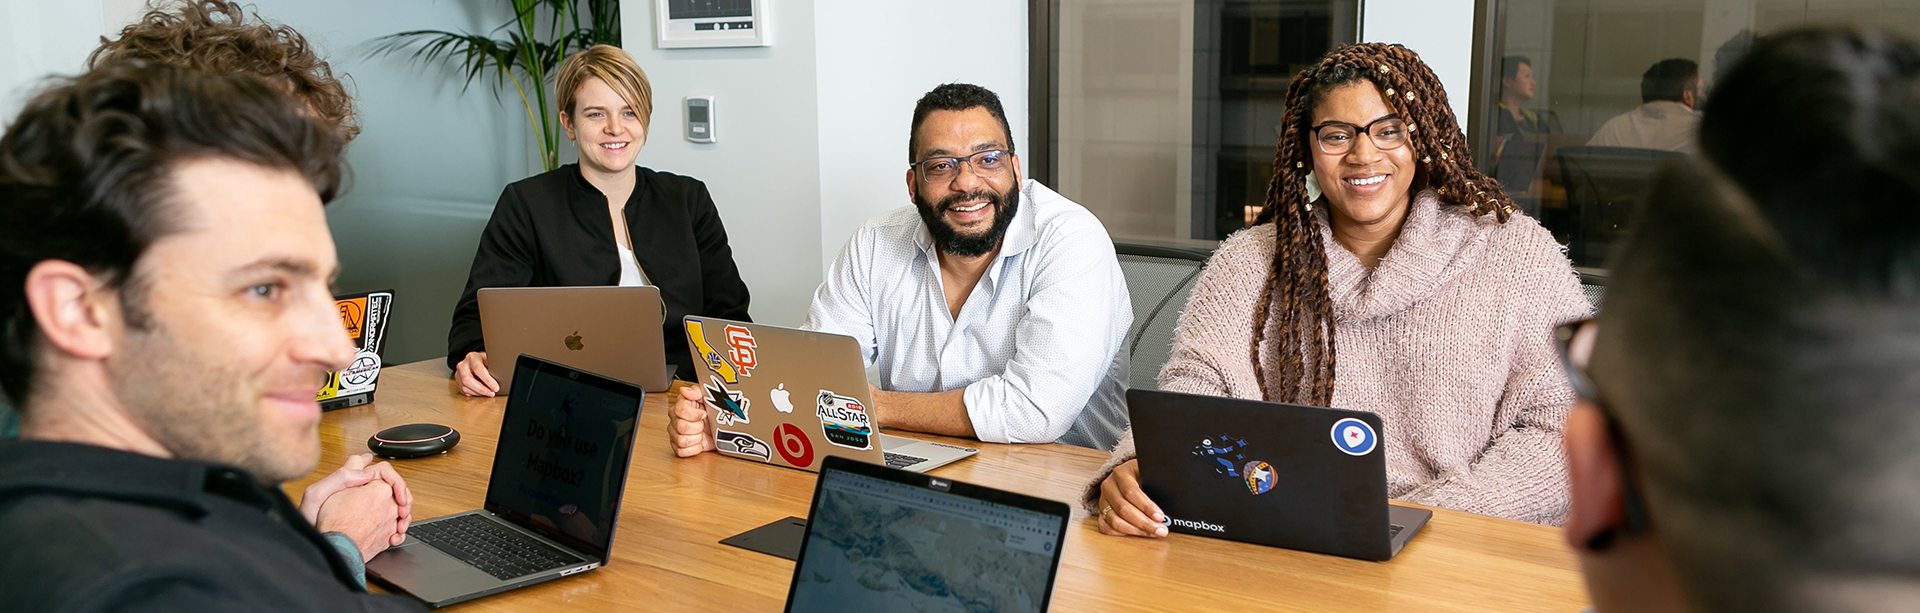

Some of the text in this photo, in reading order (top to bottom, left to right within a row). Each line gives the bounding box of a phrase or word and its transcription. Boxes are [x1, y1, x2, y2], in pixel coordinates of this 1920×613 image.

[527, 419, 598, 459] Do you use
[846, 435, 864, 443] JOSE
[526, 451, 586, 488] Mapbox?
[1173, 518, 1225, 533] mapbox
